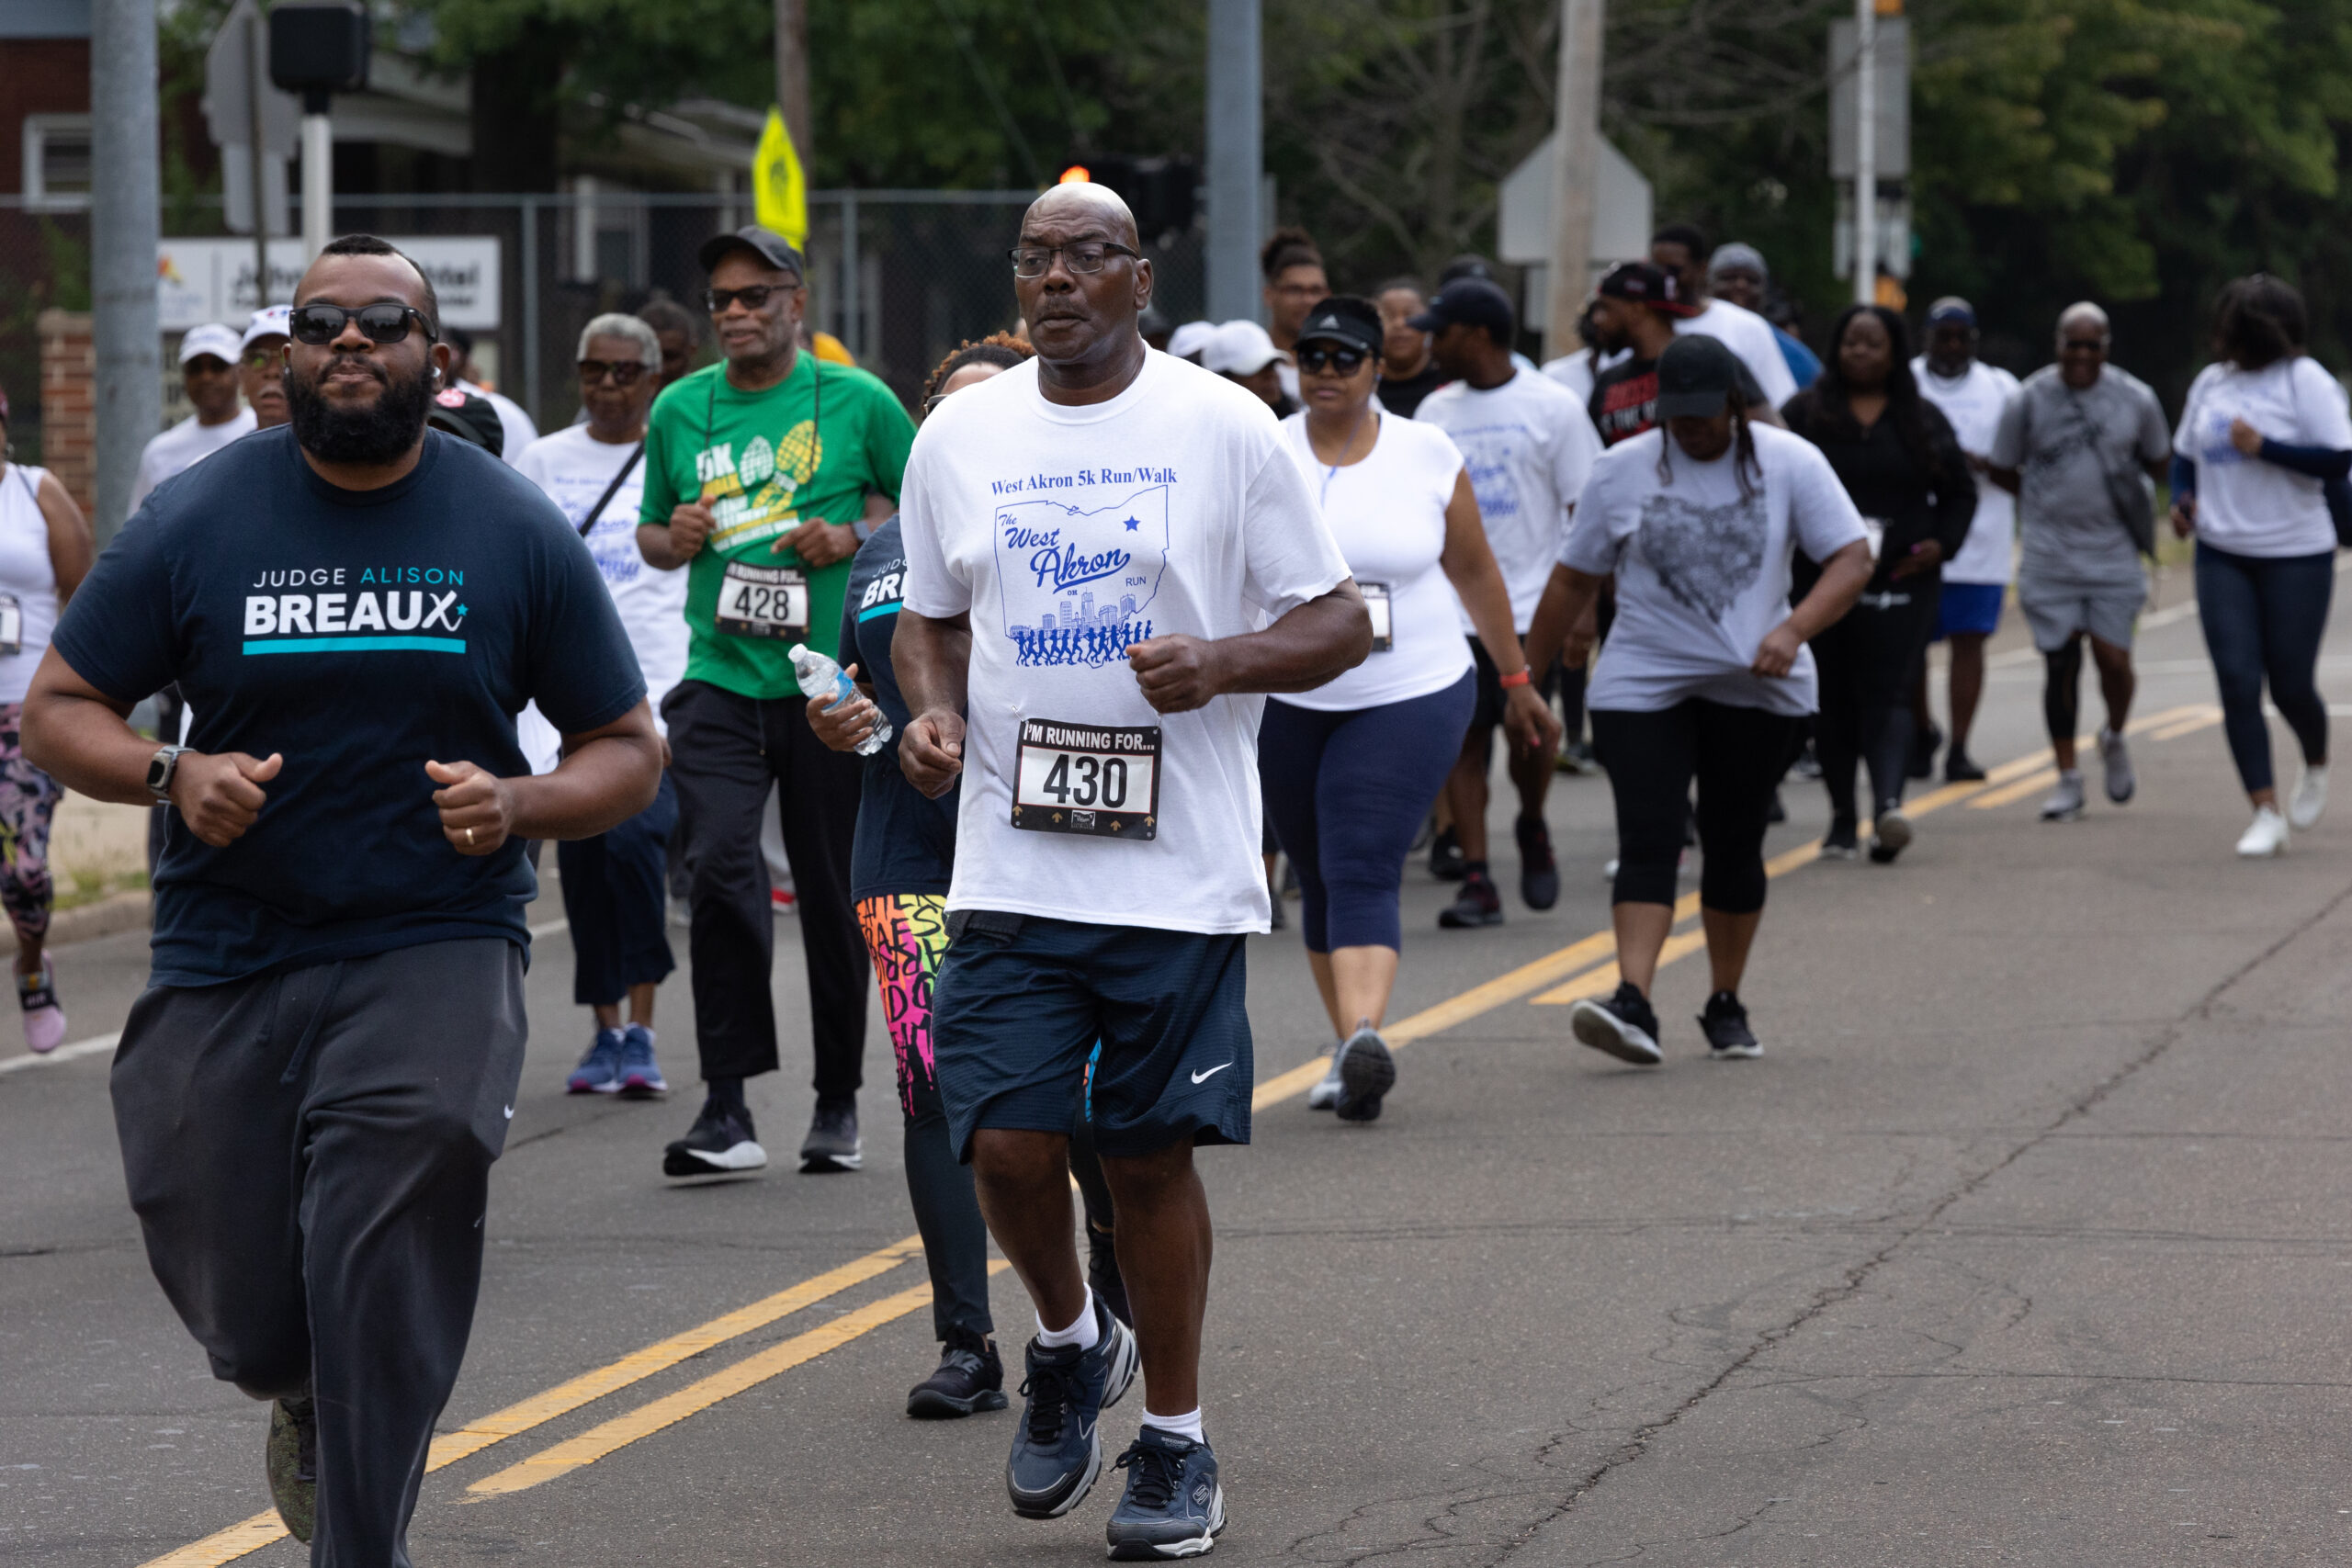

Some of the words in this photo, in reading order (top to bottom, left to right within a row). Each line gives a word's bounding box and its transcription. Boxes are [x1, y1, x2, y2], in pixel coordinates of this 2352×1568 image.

[991, 479, 1023, 496] West
[1026, 473, 1073, 491] Akron
[1078, 469, 1096, 487] 5k
[1101, 468, 1177, 484] Run/Walk
[999, 513, 1017, 526] The
[1004, 528, 1060, 549] West
[253, 568, 346, 588] JUDGE
[360, 567, 463, 586] ALISON
[1029, 542, 1131, 594] Akron
[1125, 577, 1147, 587] RUN
[243, 590, 463, 635] BREAUX
[735, 586, 789, 621] 428
[1023, 724, 1043, 742] I'M
[1046, 727, 1111, 750] RUNNING
[1114, 733, 1155, 750] FOR...
[1043, 753, 1127, 808] 430
